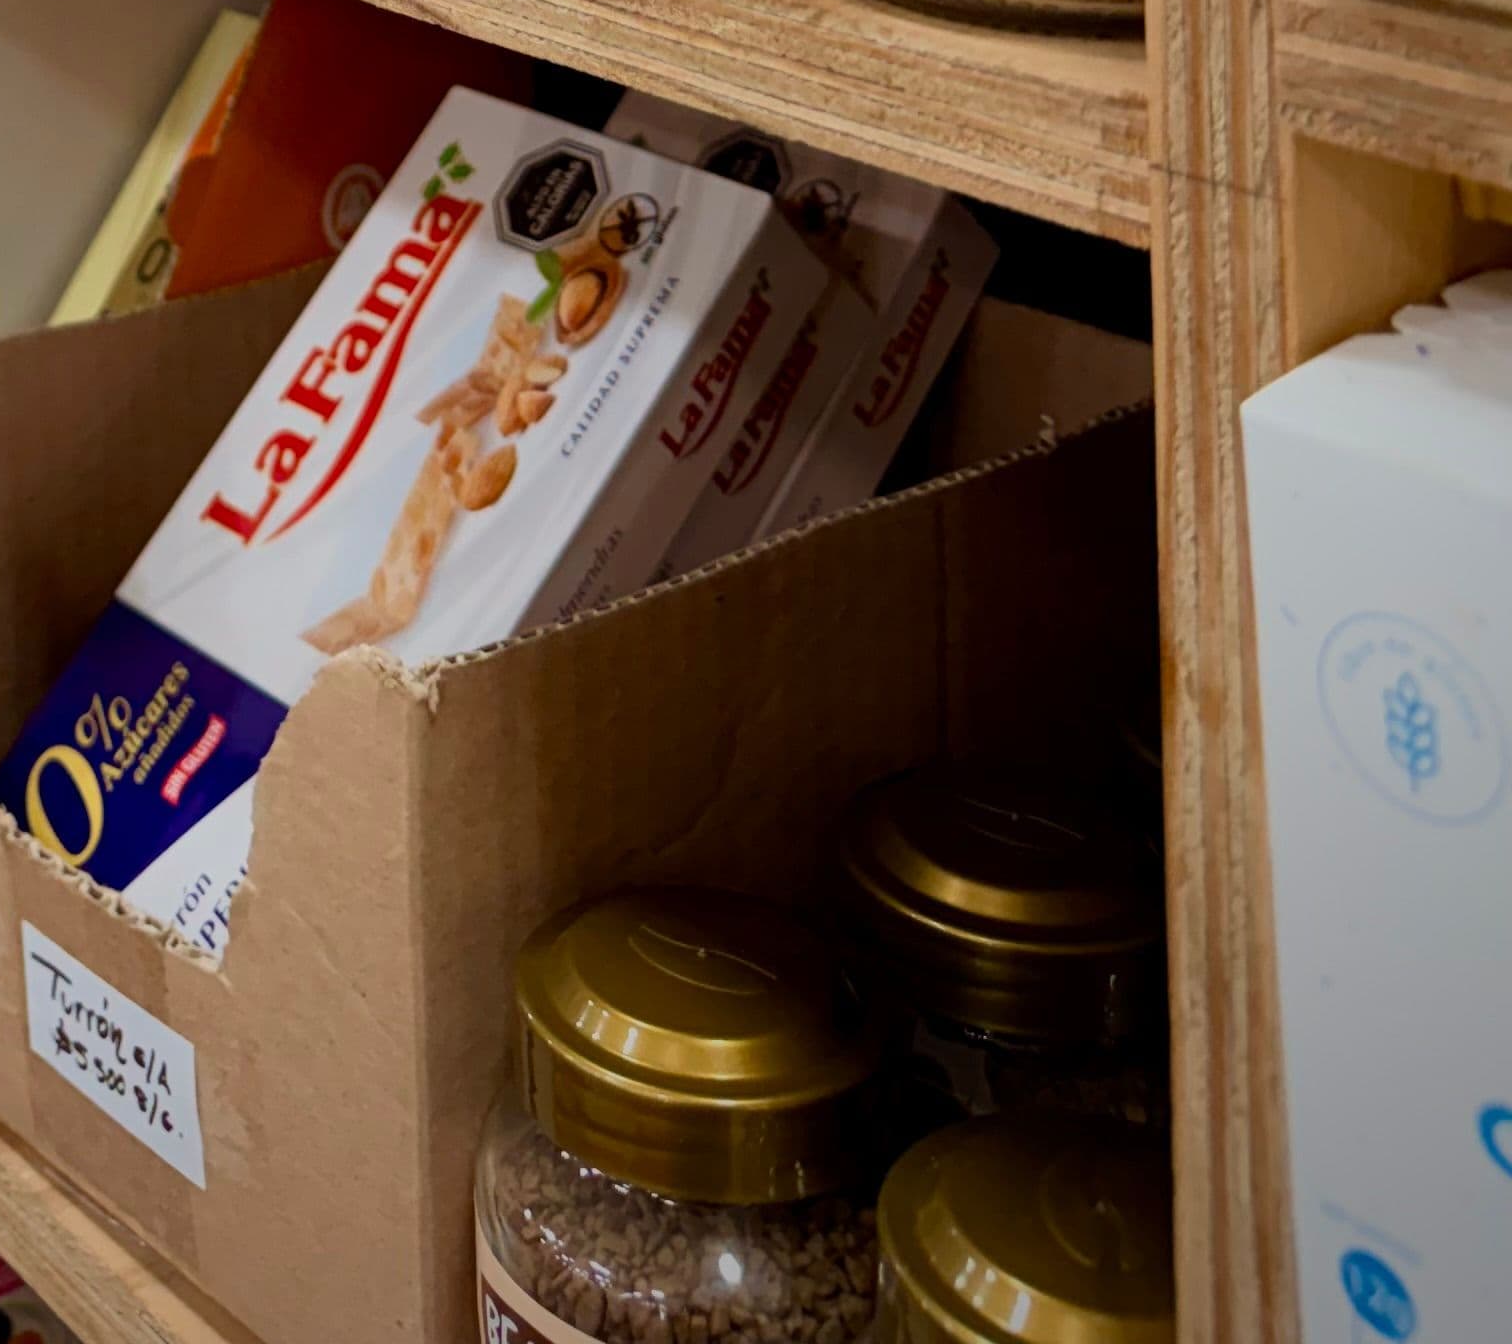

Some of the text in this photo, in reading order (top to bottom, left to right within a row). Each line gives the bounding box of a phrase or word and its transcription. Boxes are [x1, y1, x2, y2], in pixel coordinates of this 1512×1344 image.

[201, 194, 473, 546] La Fama
[560, 276, 681, 459] CALIDAD SUPREMA
[660, 288, 773, 459] La Fama
